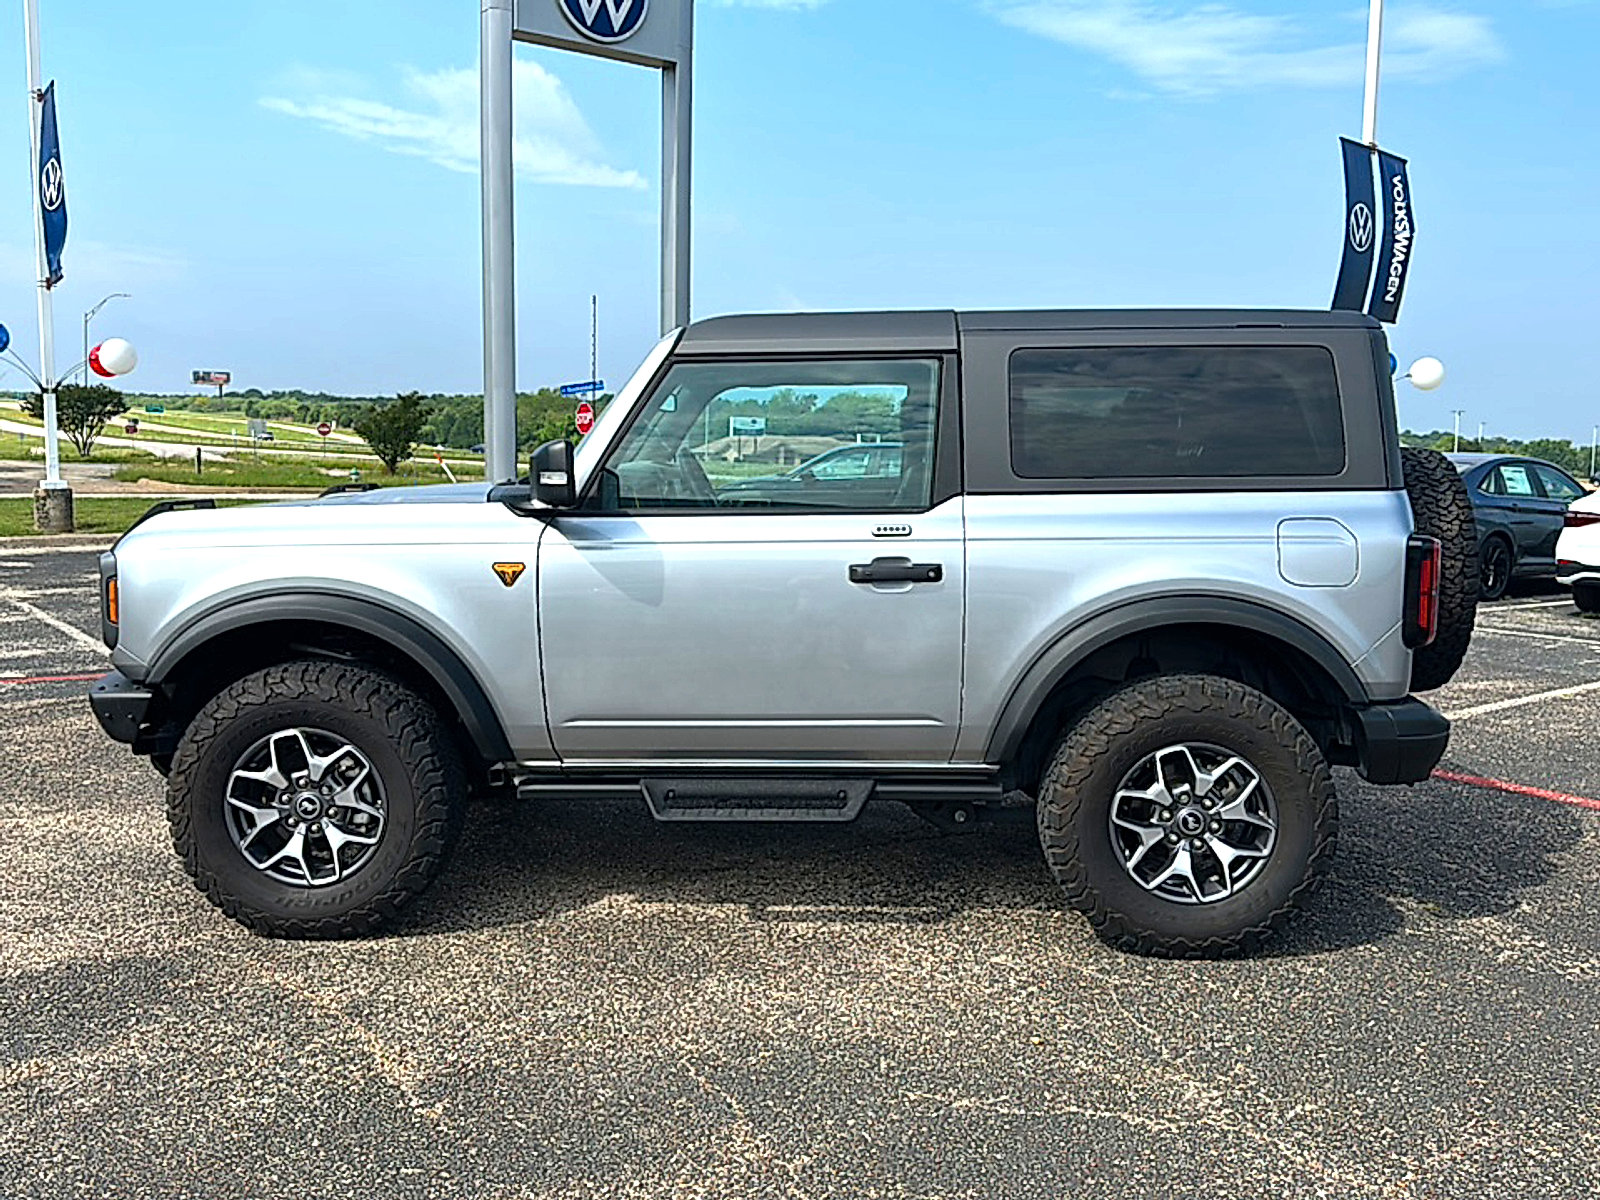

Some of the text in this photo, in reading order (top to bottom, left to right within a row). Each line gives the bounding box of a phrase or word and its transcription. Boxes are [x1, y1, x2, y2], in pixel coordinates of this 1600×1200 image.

[42, 158, 61, 210] VW
[1350, 203, 1372, 251] VW
[1384, 174, 1411, 302] VOLKSWAGEN
